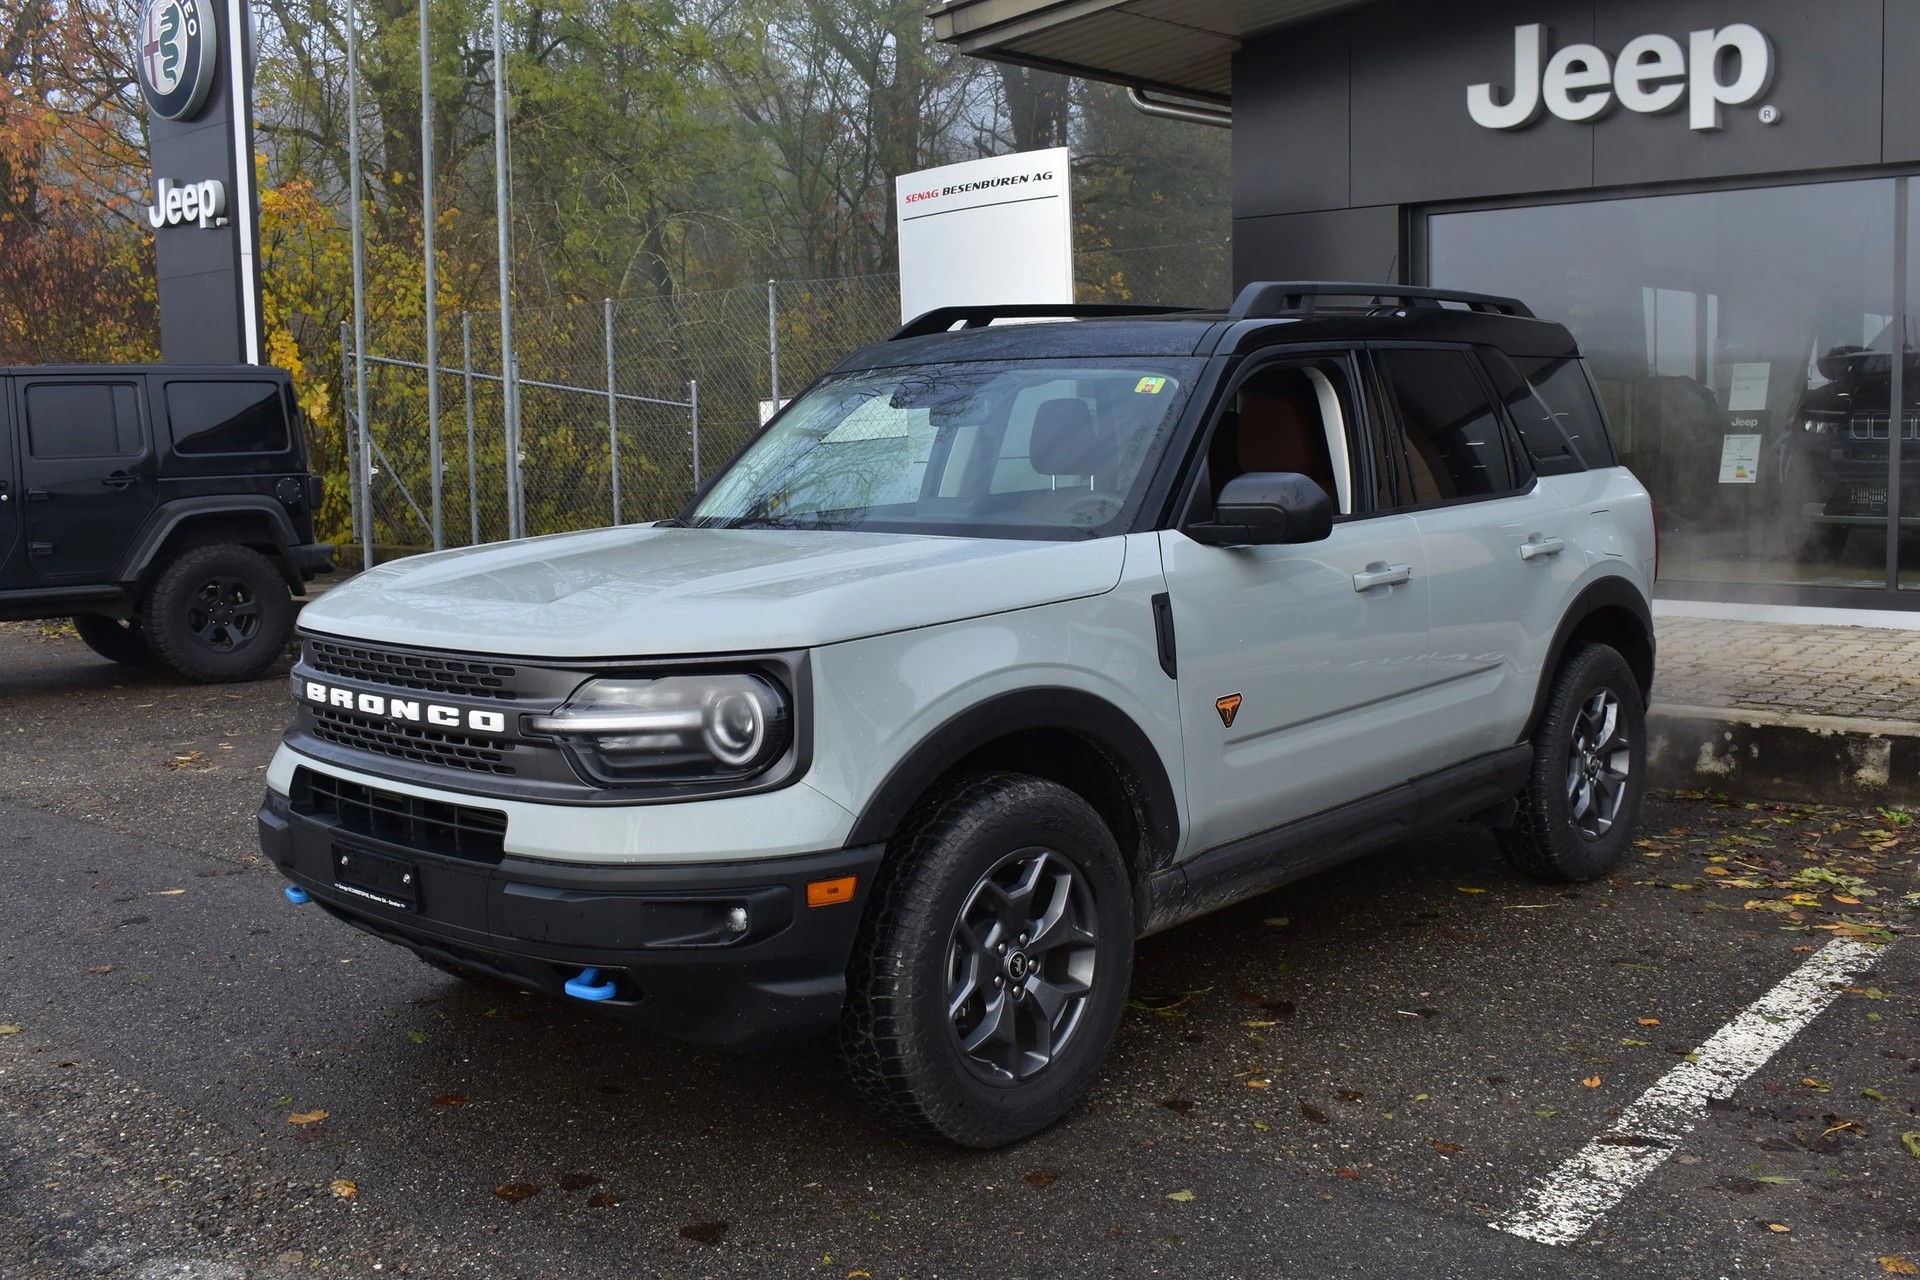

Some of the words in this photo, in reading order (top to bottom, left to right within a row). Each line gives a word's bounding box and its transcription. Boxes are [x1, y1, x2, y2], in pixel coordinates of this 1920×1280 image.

[1467, 23, 1772, 131] Jeep
[149, 178, 223, 229] Jeep
[905, 189, 939, 204] SENAG
[942, 174, 1030, 196] BESENBÜREN
[1032, 171, 1053, 182] AG
[1731, 417, 1758, 428] Jeep
[306, 681, 505, 732] BRONCO
